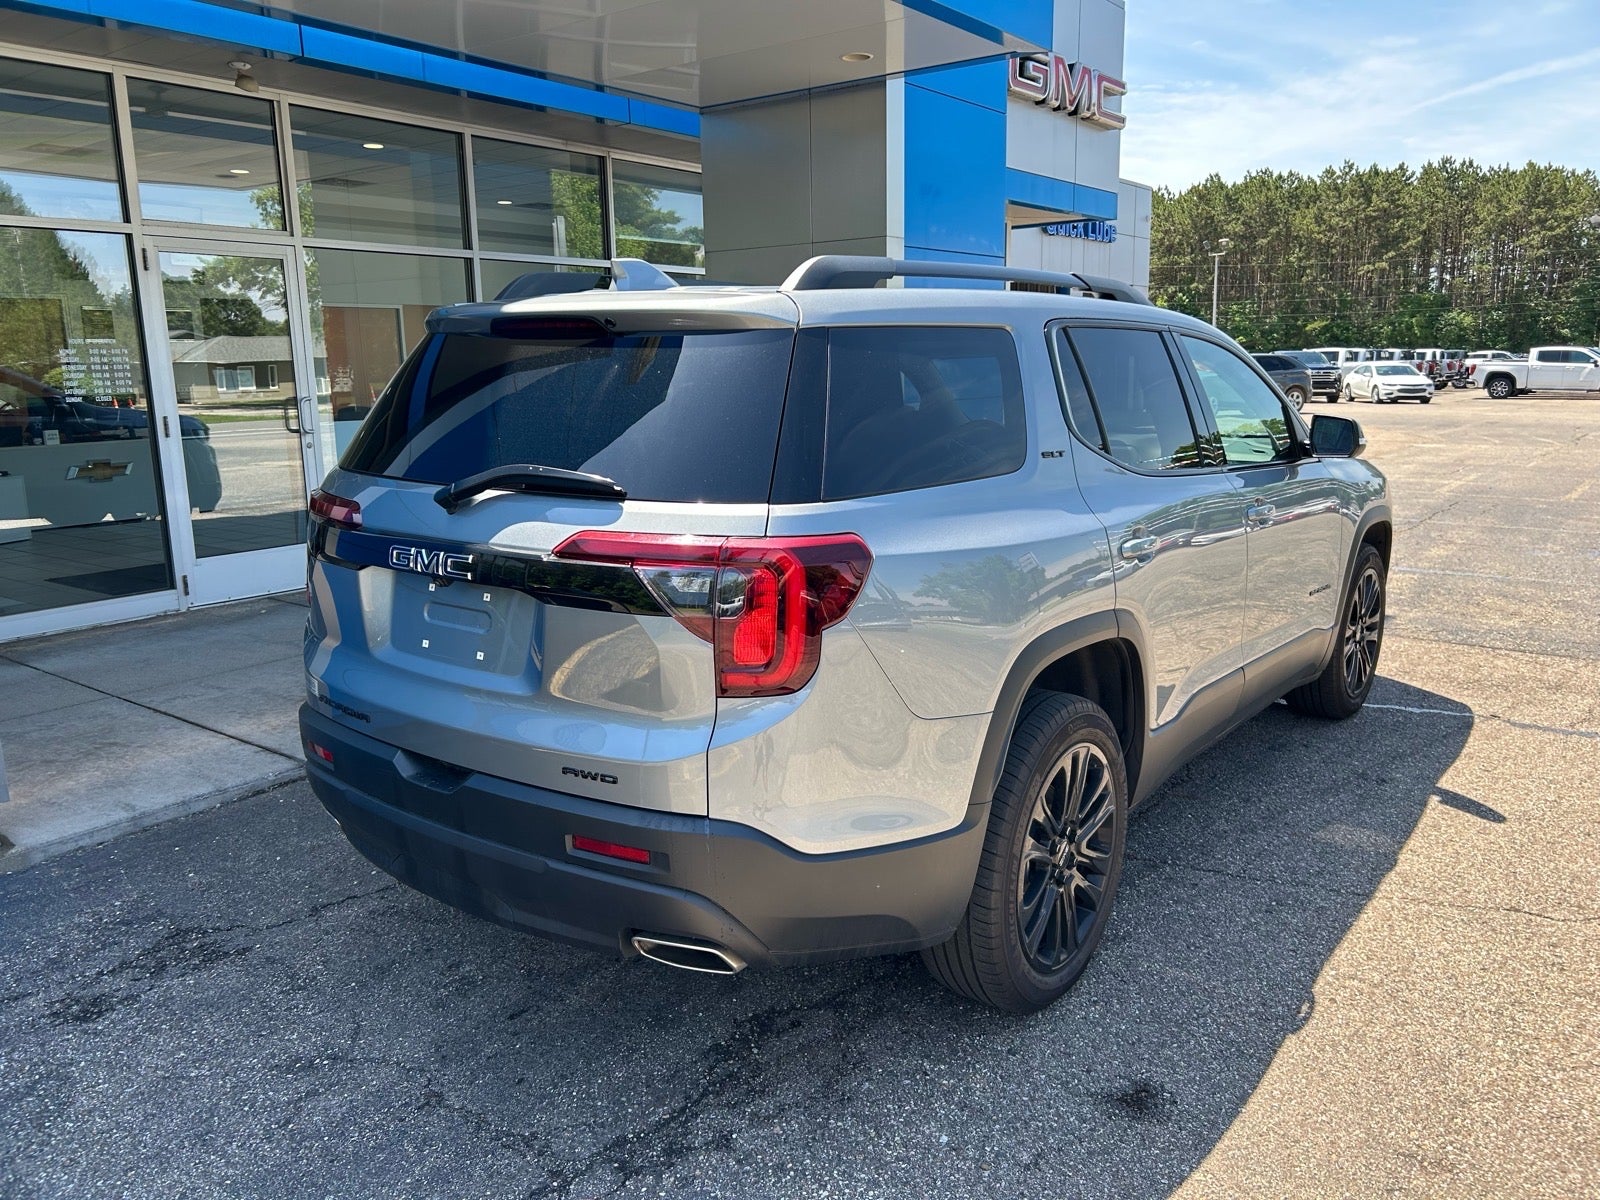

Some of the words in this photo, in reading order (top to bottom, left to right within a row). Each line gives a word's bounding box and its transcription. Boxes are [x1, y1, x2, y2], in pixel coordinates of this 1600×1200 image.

[1008, 54, 1127, 130] GMC
[1088, 220, 1117, 242] Lube
[1041, 450, 1066, 458] SLT
[389, 545, 473, 580] GMC
[562, 767, 618, 784] AWD
